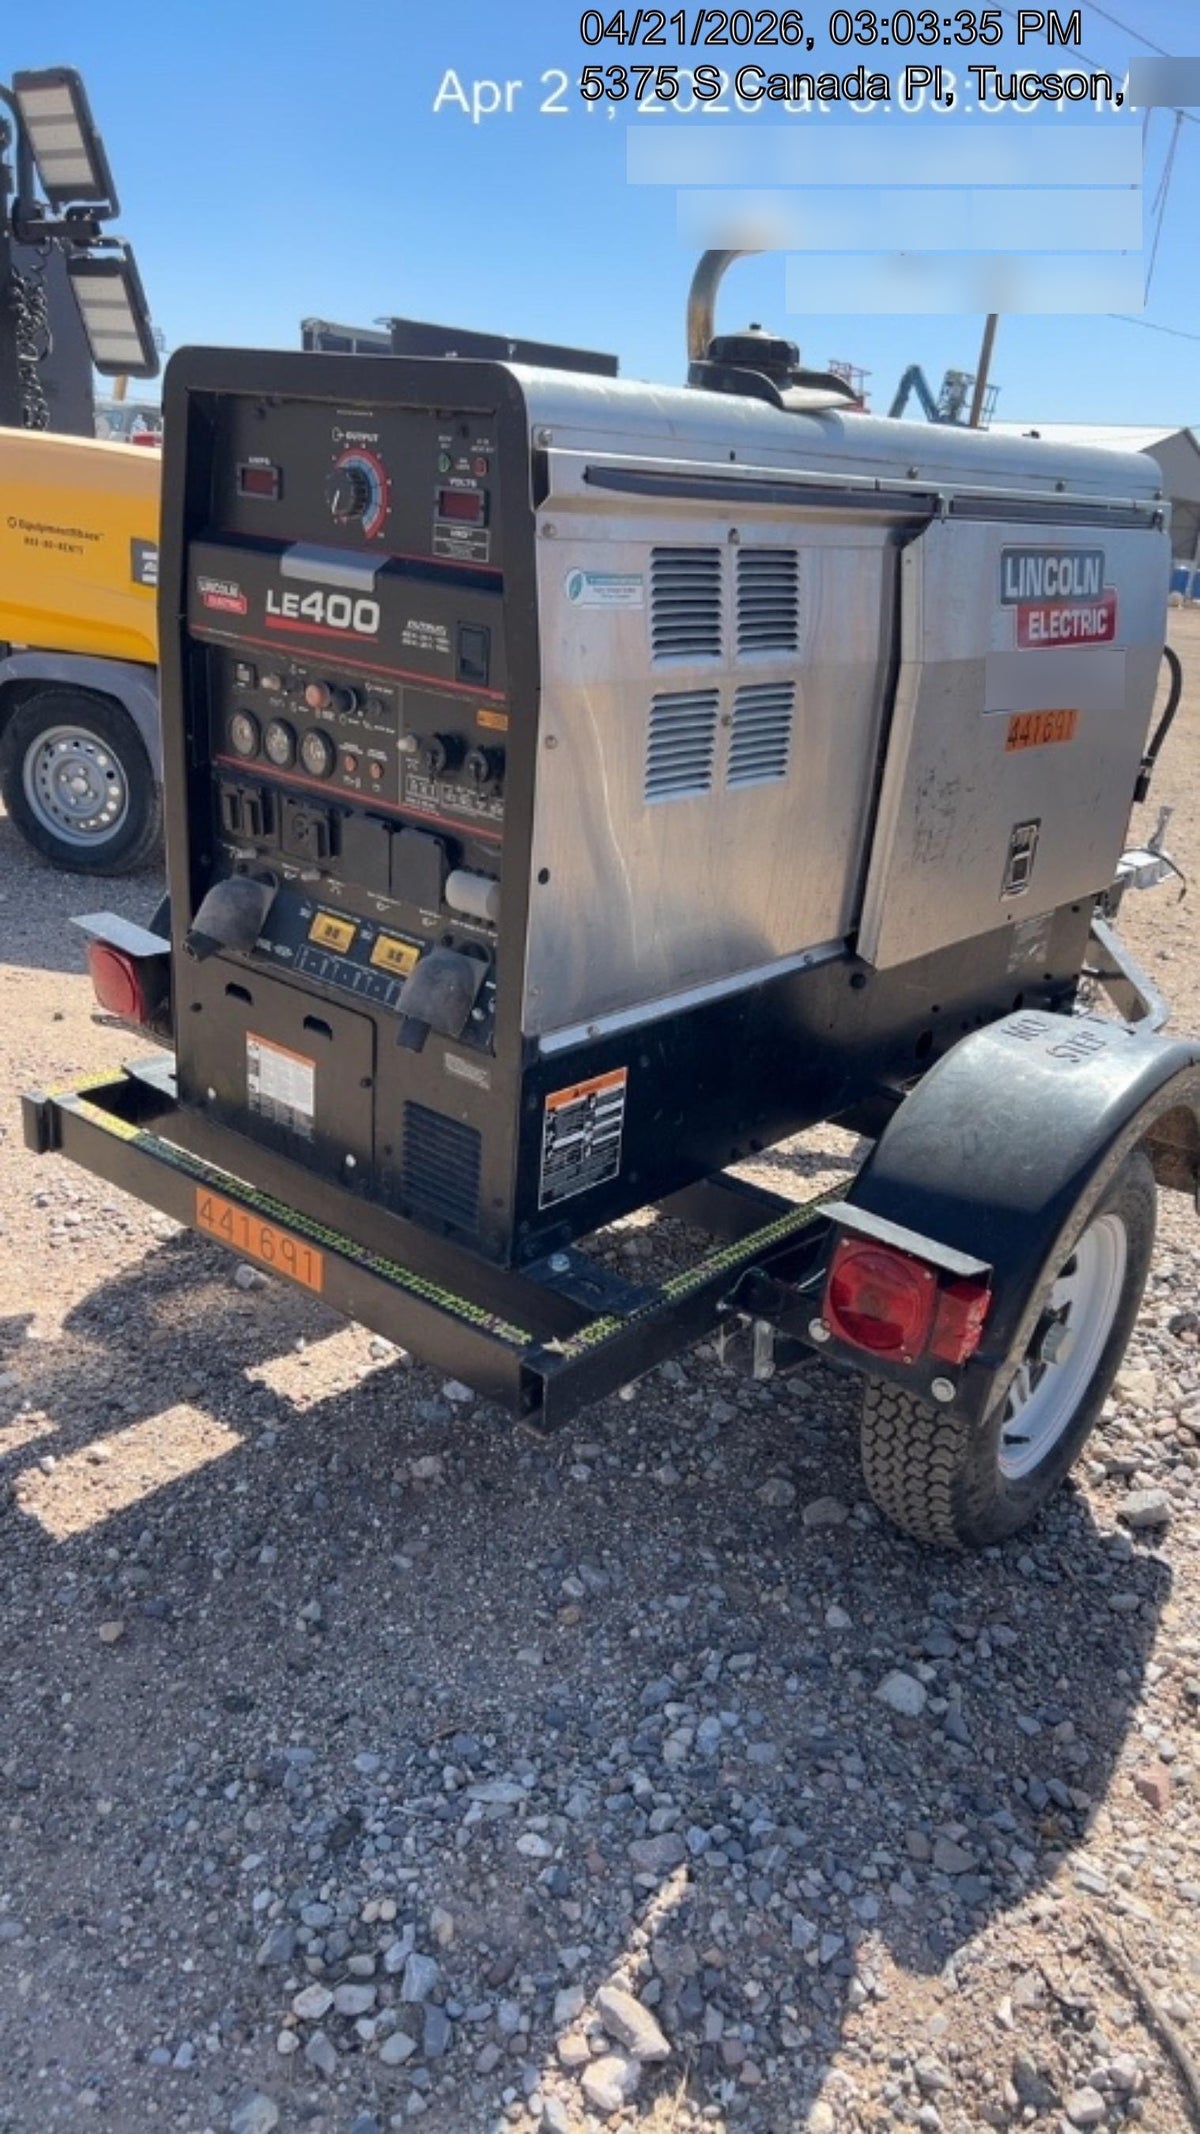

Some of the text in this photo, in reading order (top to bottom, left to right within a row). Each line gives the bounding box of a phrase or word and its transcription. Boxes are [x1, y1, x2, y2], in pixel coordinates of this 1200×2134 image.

[1004, 555, 1100, 598] LINCOLN
[265, 589, 381, 634] LE400
[1027, 608, 1109, 642] ELECTRIC
[1007, 710, 1076, 748] 441691
[1001, 1017, 1051, 1042] NO
[1045, 1030, 1108, 1063] STEP
[201, 1197, 314, 1284] 441691
